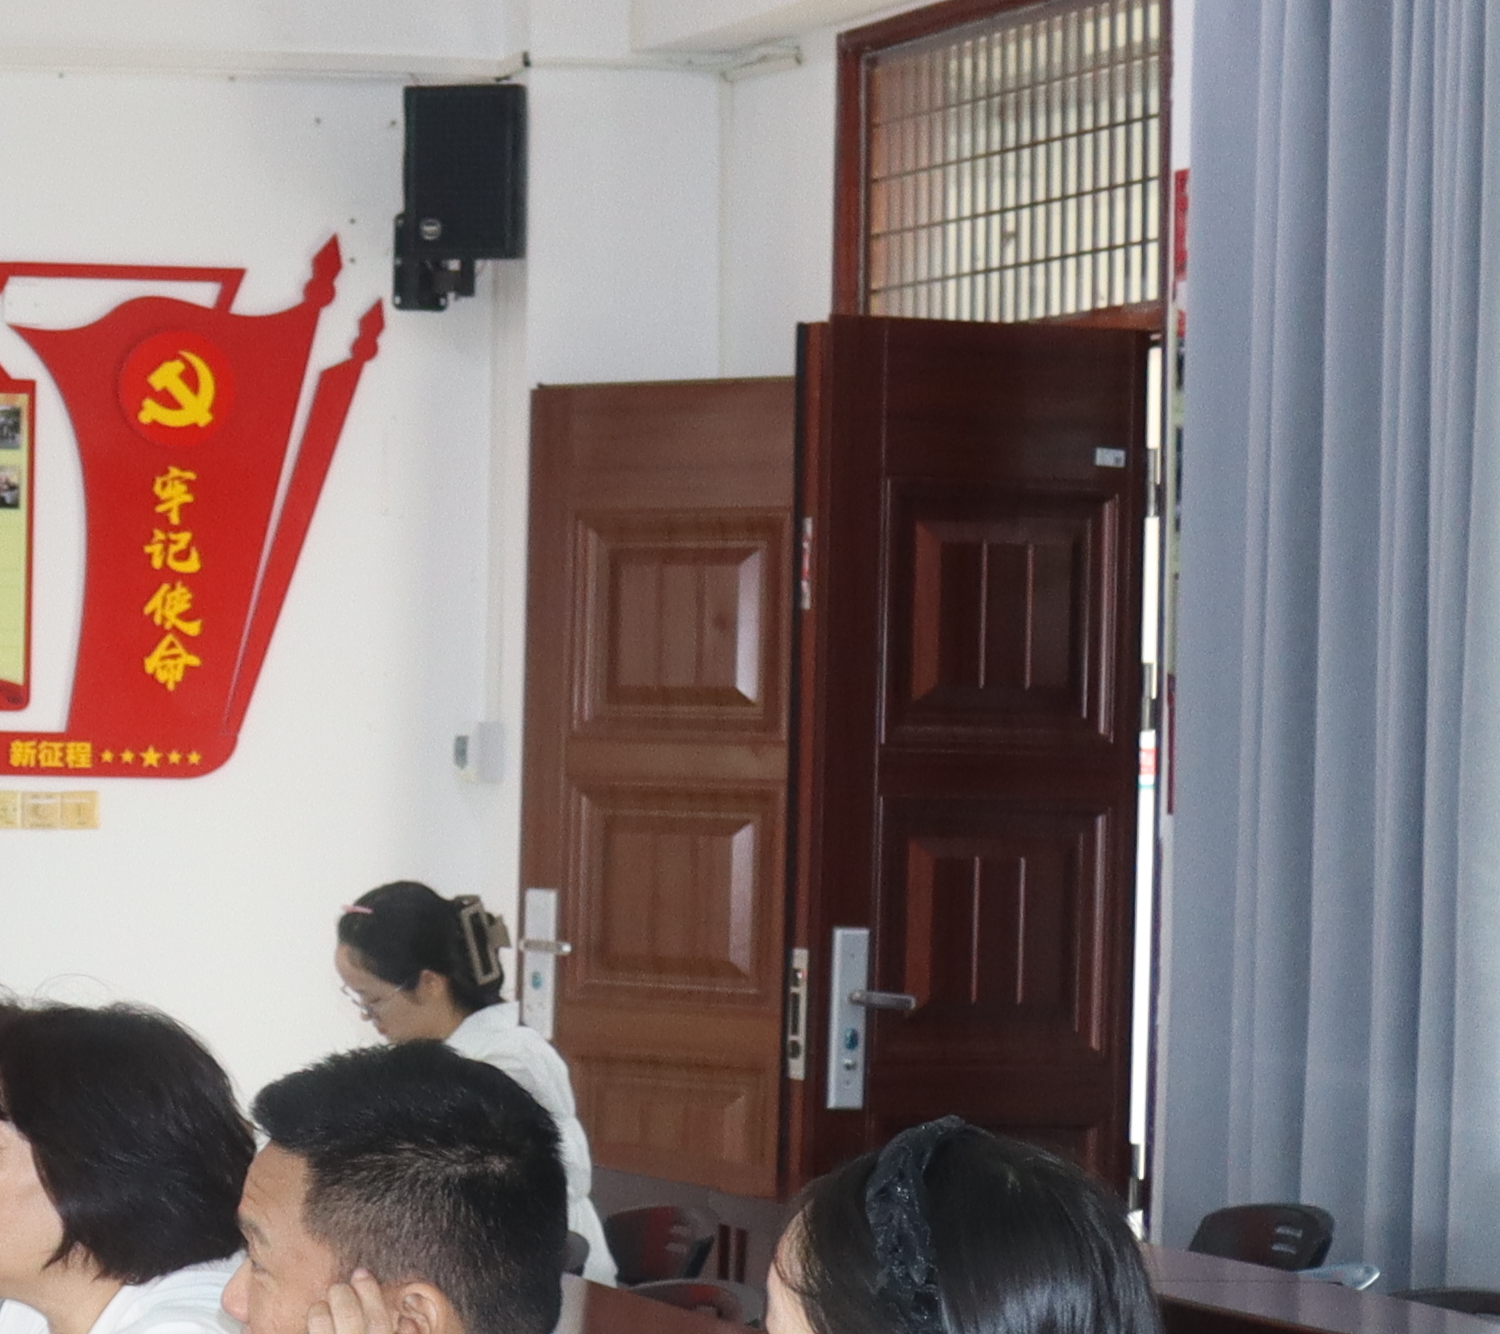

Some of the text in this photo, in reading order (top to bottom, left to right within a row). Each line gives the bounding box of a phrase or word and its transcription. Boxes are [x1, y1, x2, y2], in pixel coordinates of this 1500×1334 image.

[143, 466, 203, 691] 牢记使命
[9, 739, 93, 769] 新征程
